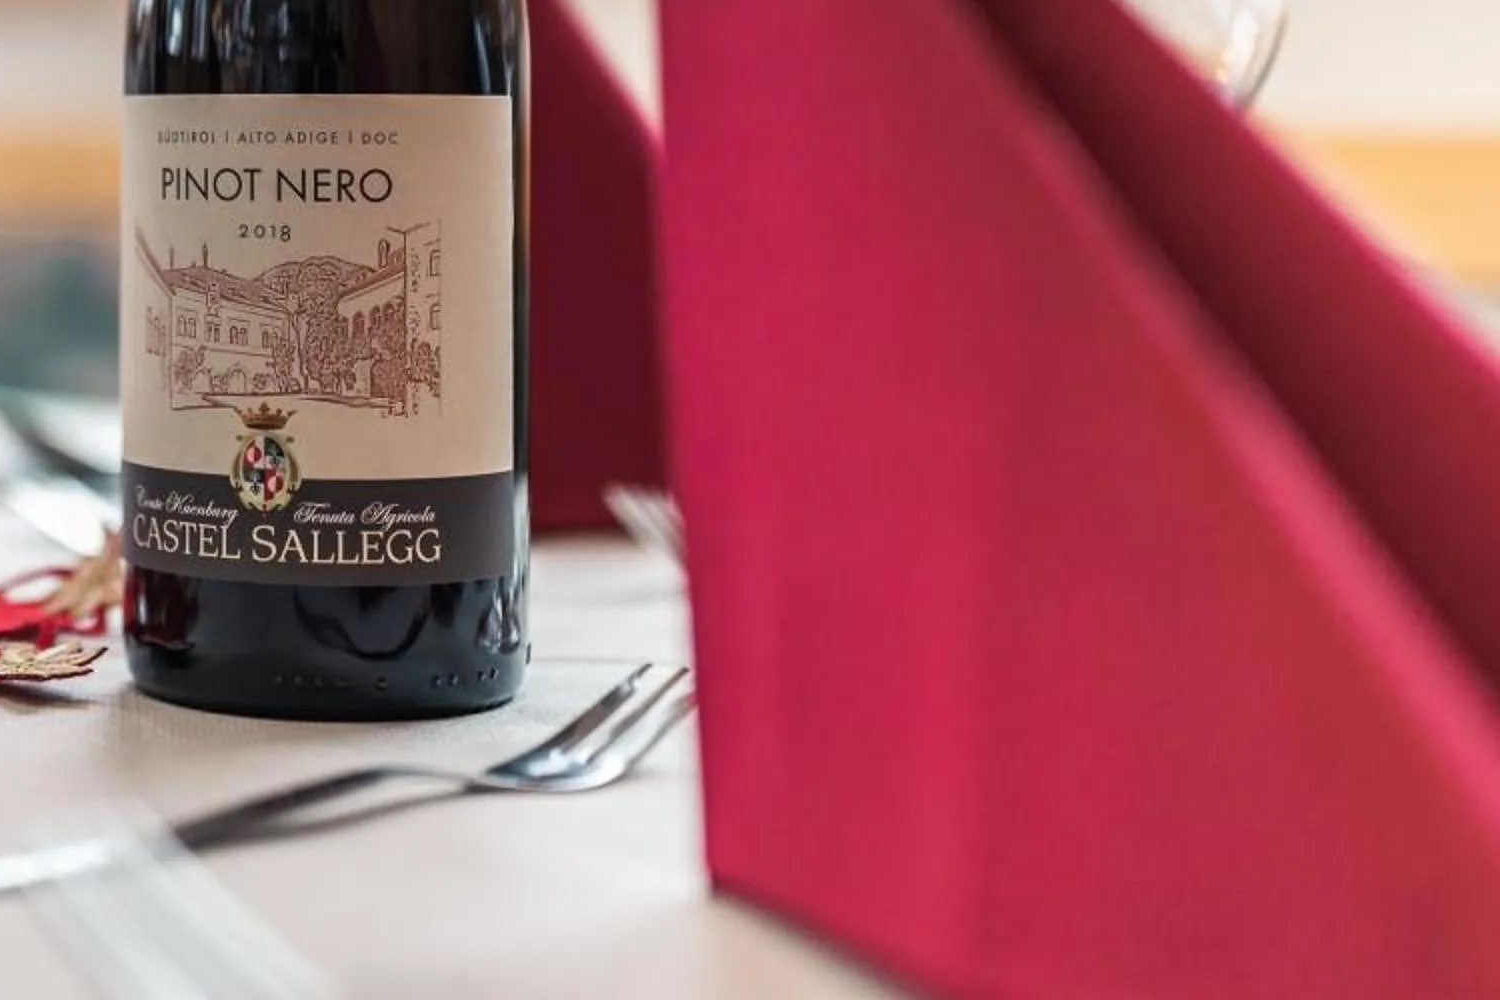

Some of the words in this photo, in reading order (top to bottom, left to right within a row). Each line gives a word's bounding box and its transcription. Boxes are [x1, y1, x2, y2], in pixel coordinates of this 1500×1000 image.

[237, 131, 277, 145] ALTO
[285, 131, 339, 145] ADIGE
[361, 131, 399, 146] DOC
[160, 167, 262, 202] PINOT
[276, 168, 393, 203] NERO
[238, 224, 291, 242] 2018
[164, 489, 239, 527] Kuenburg
[293, 501, 355, 526] Tenuta
[359, 501, 437, 532] Agricola
[132, 513, 241, 560] CASTEL
[251, 524, 443, 566] SALLEGG
